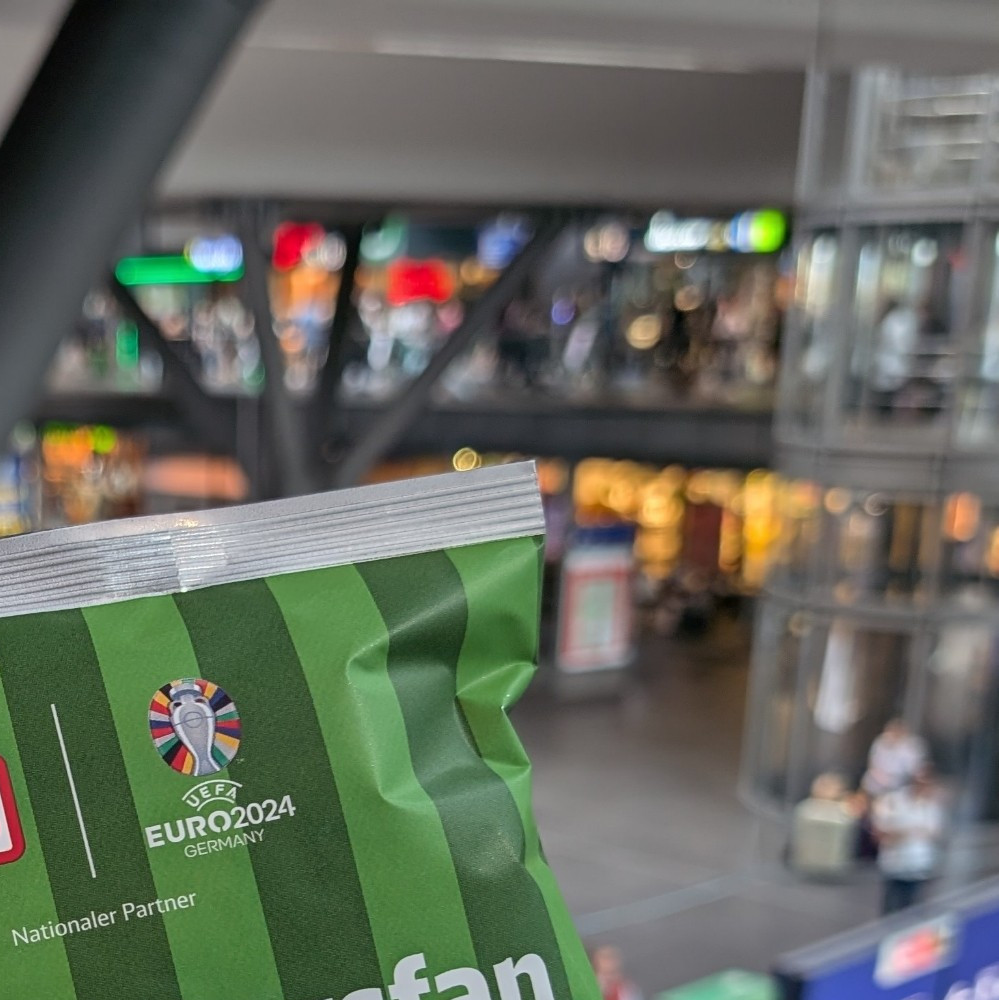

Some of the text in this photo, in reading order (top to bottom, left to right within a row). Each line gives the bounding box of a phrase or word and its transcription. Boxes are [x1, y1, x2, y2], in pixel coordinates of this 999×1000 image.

[186, 783, 237, 808] UEFA
[145, 794, 297, 848] EURO2024
[184, 828, 264, 858] GERMANY
[11, 892, 196, 946] Nationaler Partner
